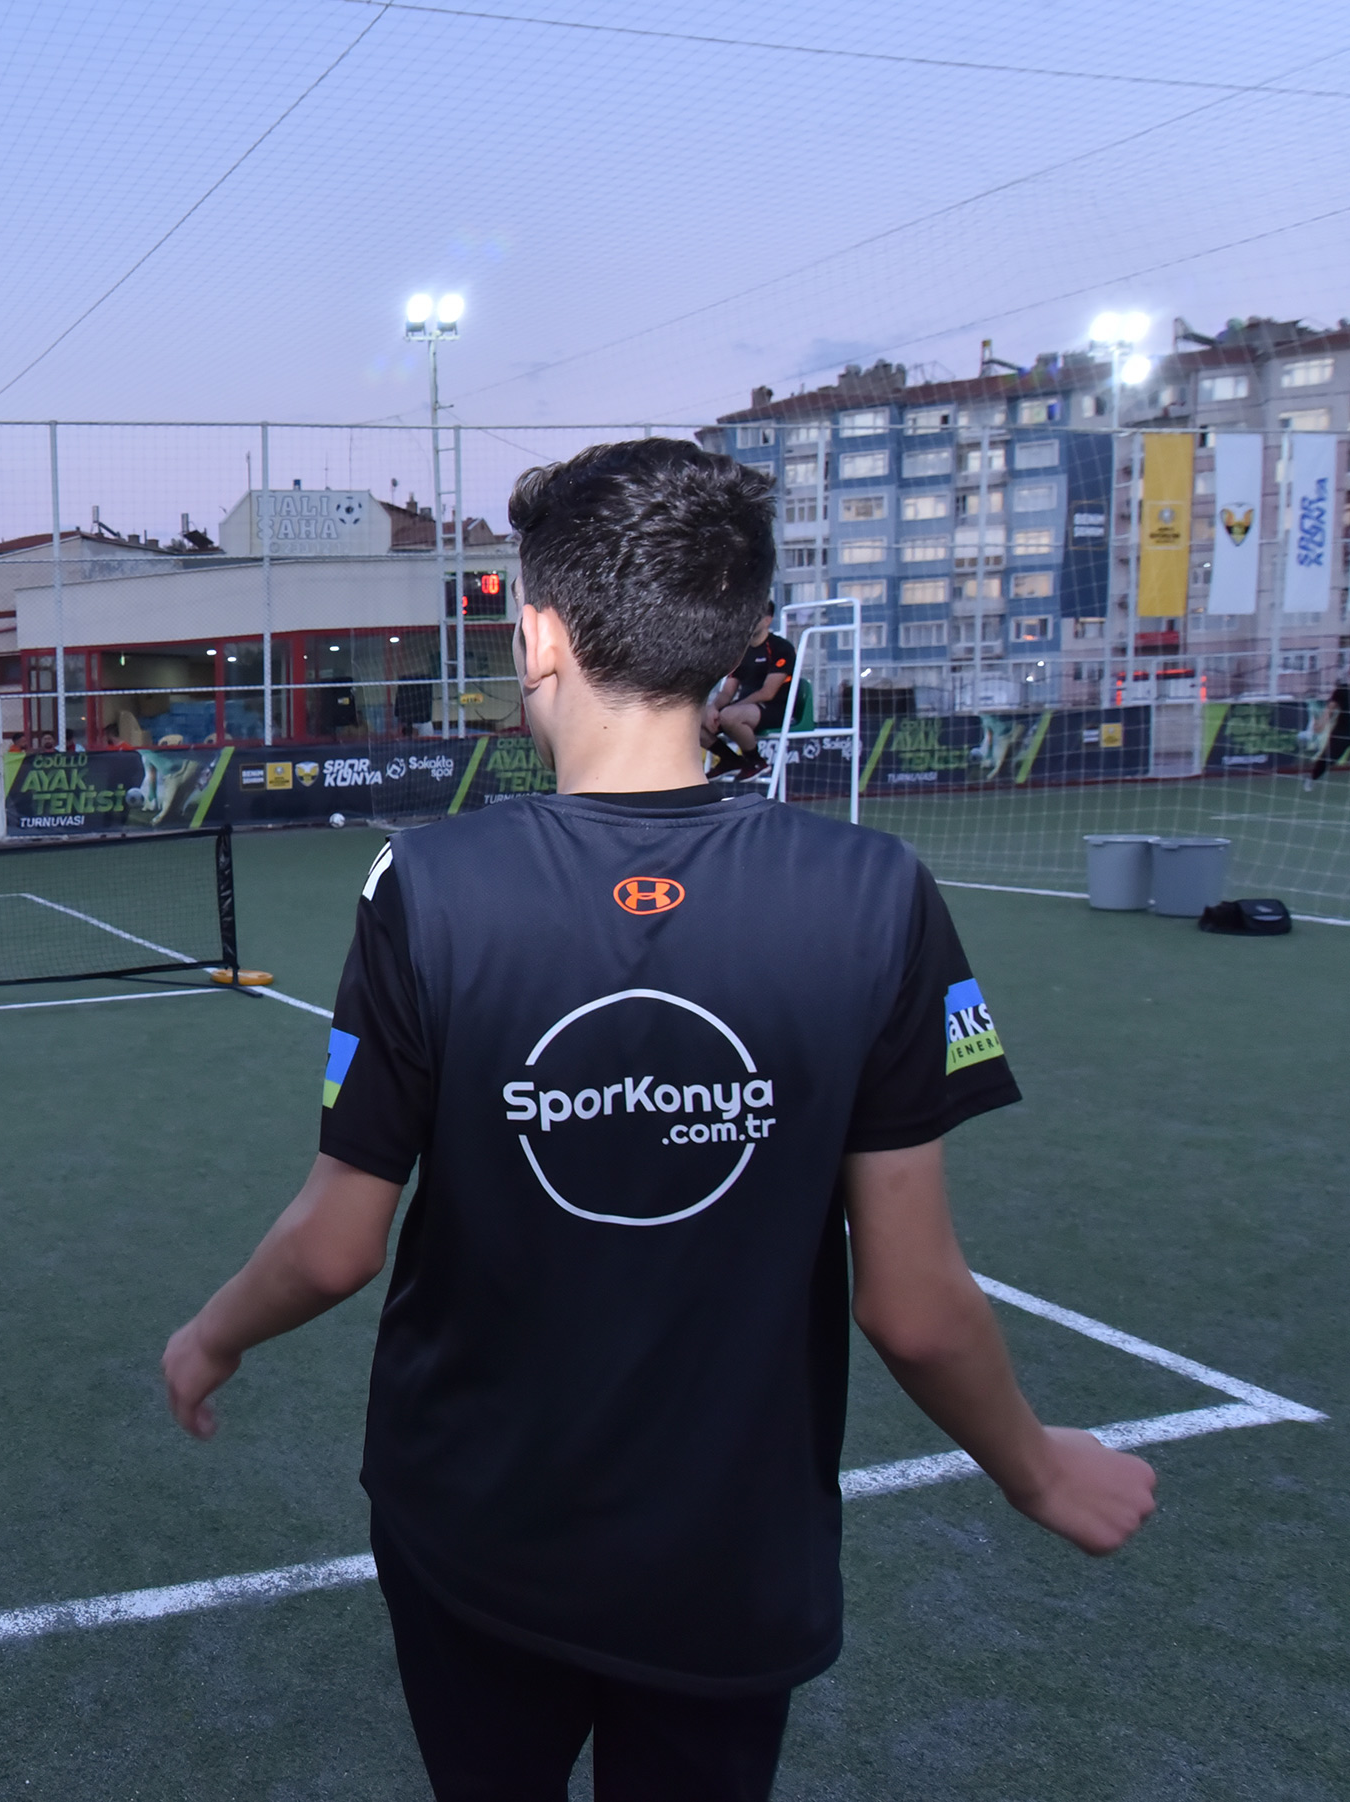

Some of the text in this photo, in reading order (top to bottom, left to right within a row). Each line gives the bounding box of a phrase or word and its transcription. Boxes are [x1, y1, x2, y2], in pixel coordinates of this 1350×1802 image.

[323, 758, 370, 774] SPOR
[408, 755, 454, 770] Sokakta
[20, 768, 89, 793] AYAK
[324, 770, 383, 787] KONYA
[430, 767, 453, 781] spor
[33, 784, 127, 815] TENİSİ
[20, 815, 85, 828] TURNUVASI
[502, 1076, 773, 1131] SporKonya
[661, 1113, 776, 1145] .com.tr
